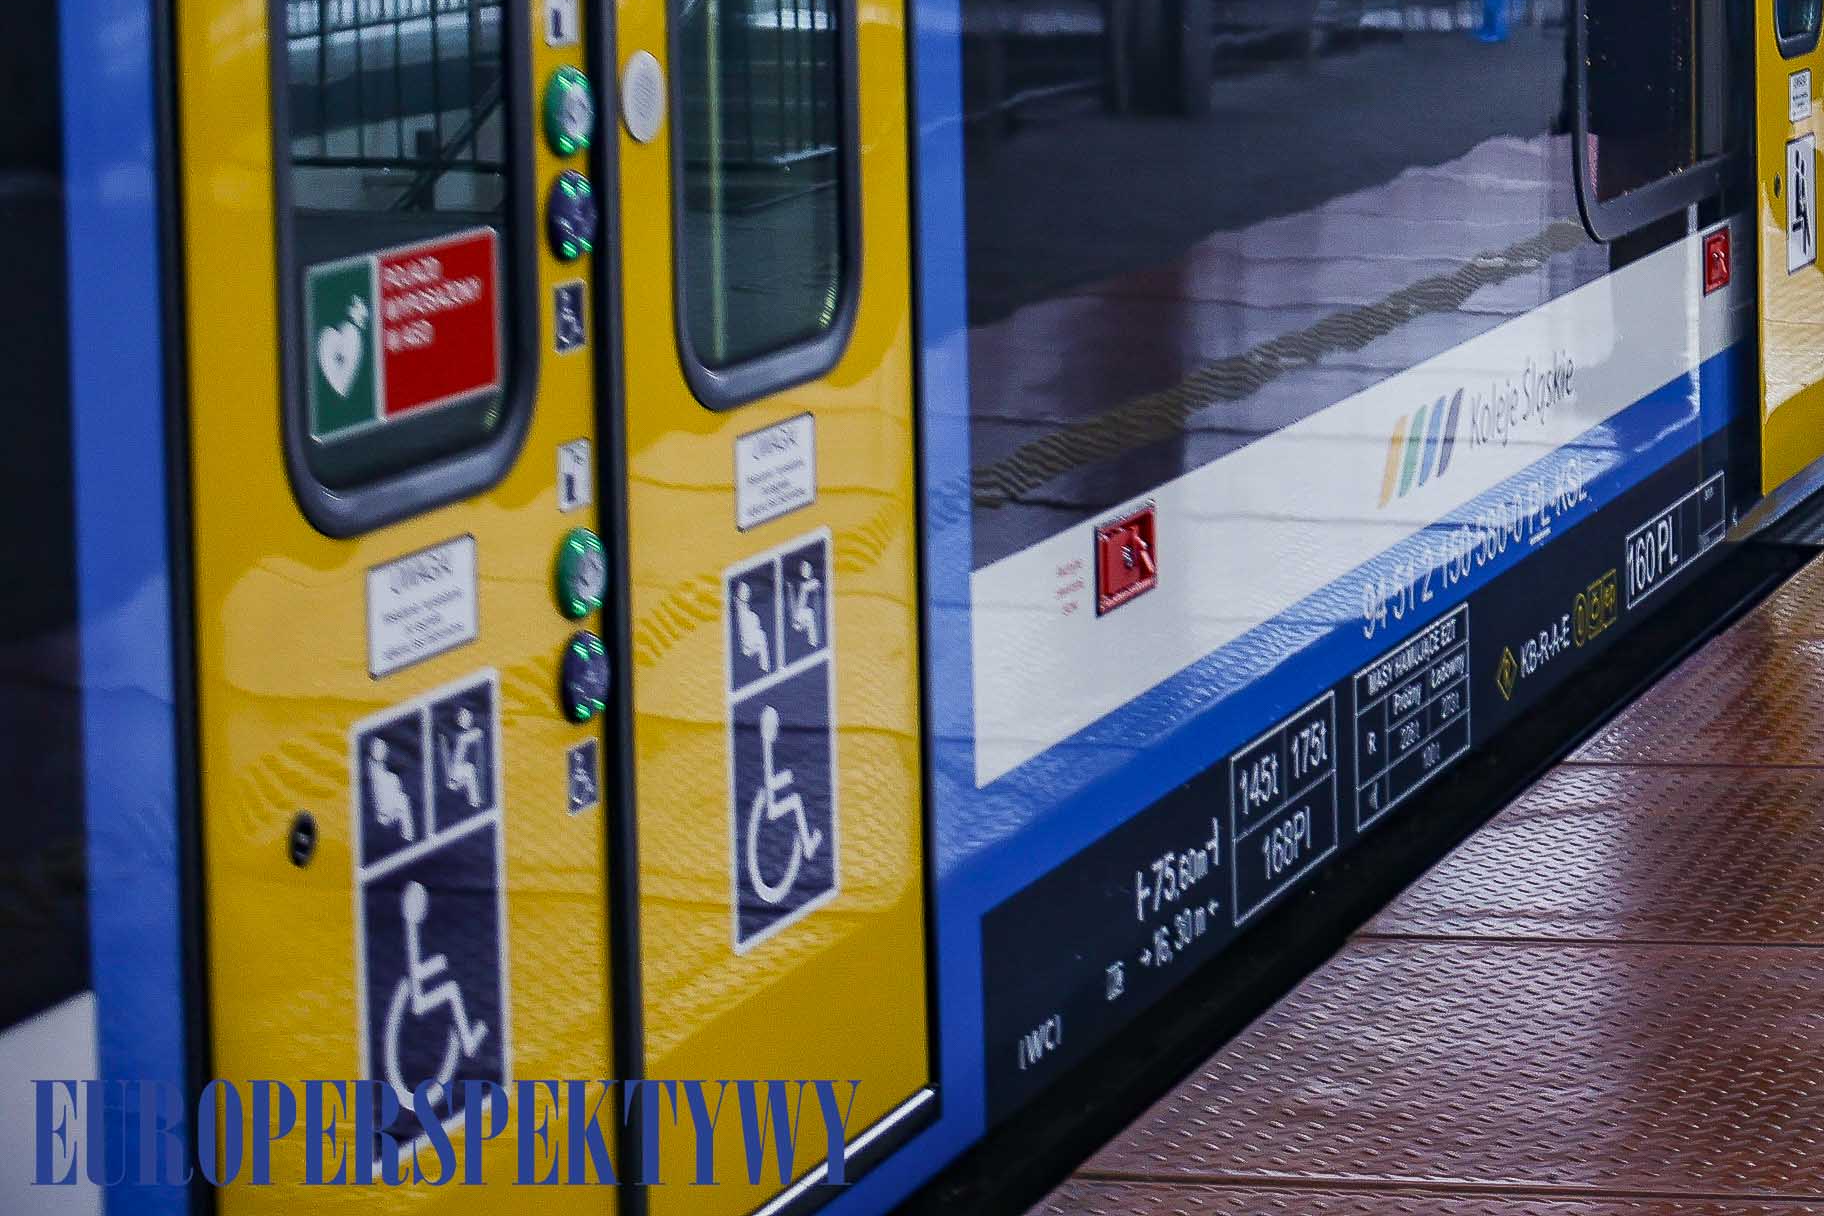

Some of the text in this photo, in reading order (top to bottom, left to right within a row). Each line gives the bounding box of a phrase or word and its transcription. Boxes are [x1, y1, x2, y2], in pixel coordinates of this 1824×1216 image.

[1470, 350, 1577, 448] Koleje Śląskie
[1240, 720, 1329, 815] 145t 175t
